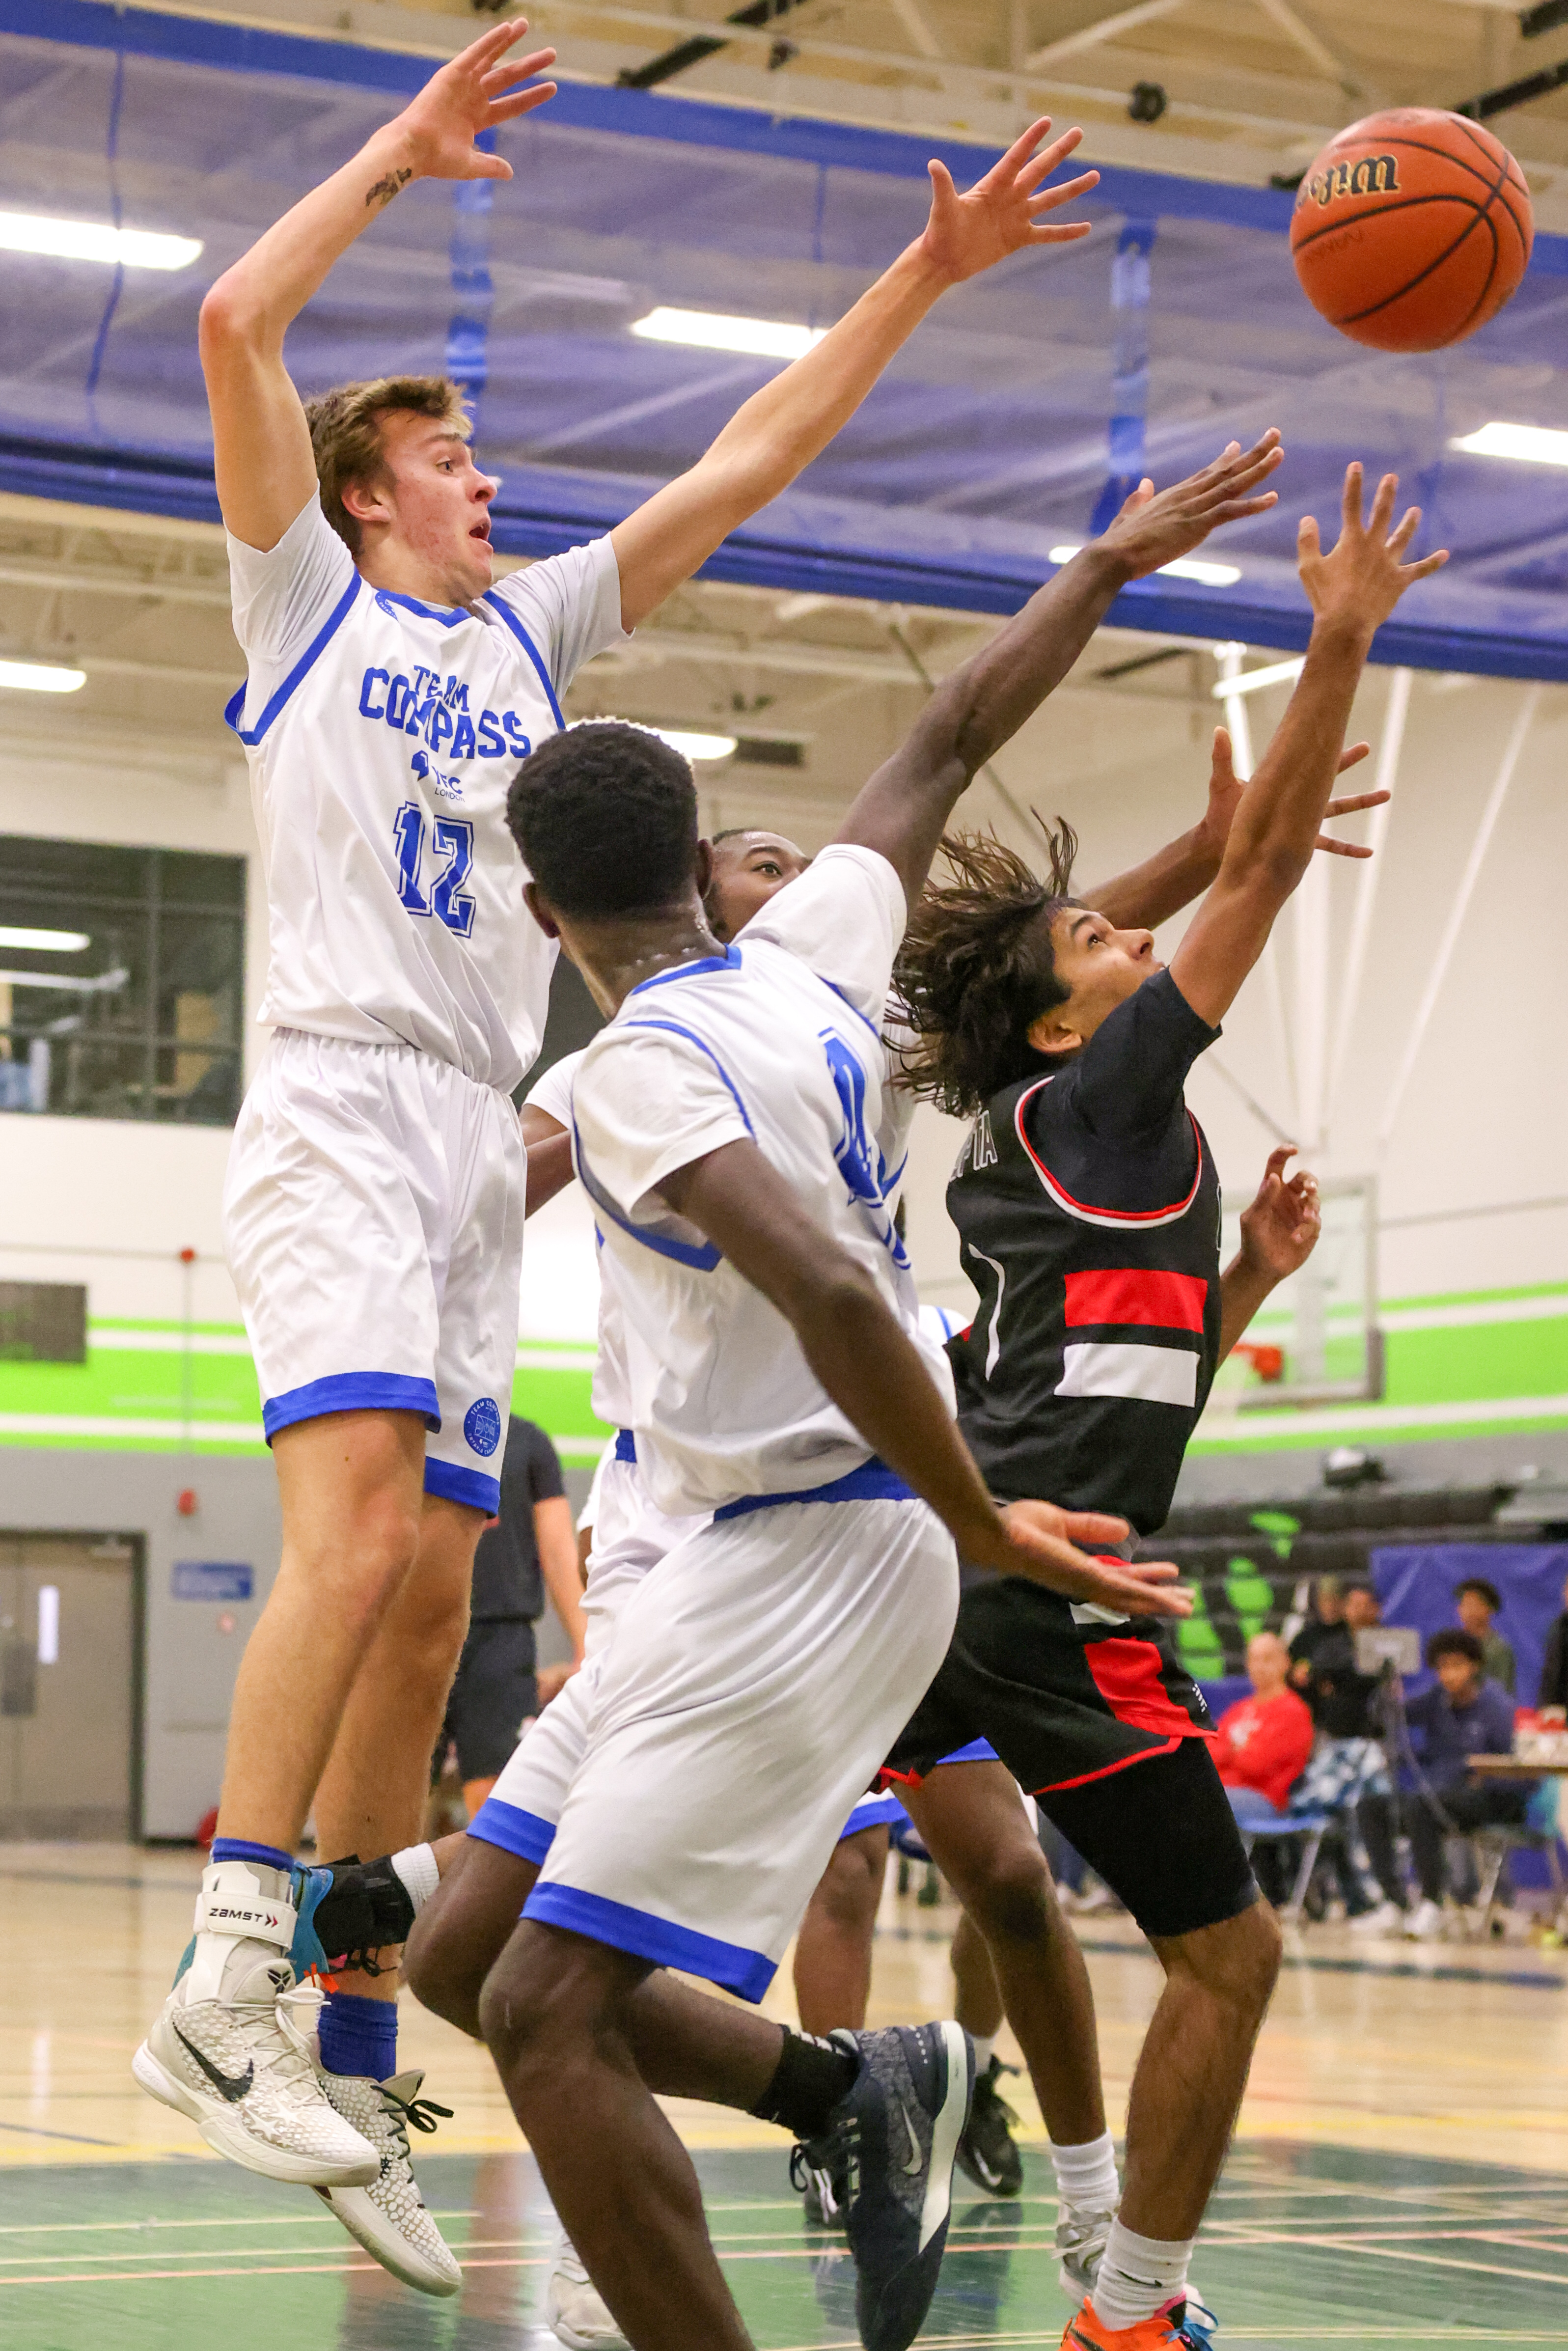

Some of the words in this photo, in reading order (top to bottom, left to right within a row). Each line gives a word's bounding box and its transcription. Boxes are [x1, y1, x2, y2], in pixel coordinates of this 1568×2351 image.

[358, 667, 531, 759] COMPASS
[413, 665, 469, 712] TEAM
[393, 801, 476, 939] 12
[471, 1401, 484, 1415] TEAM
